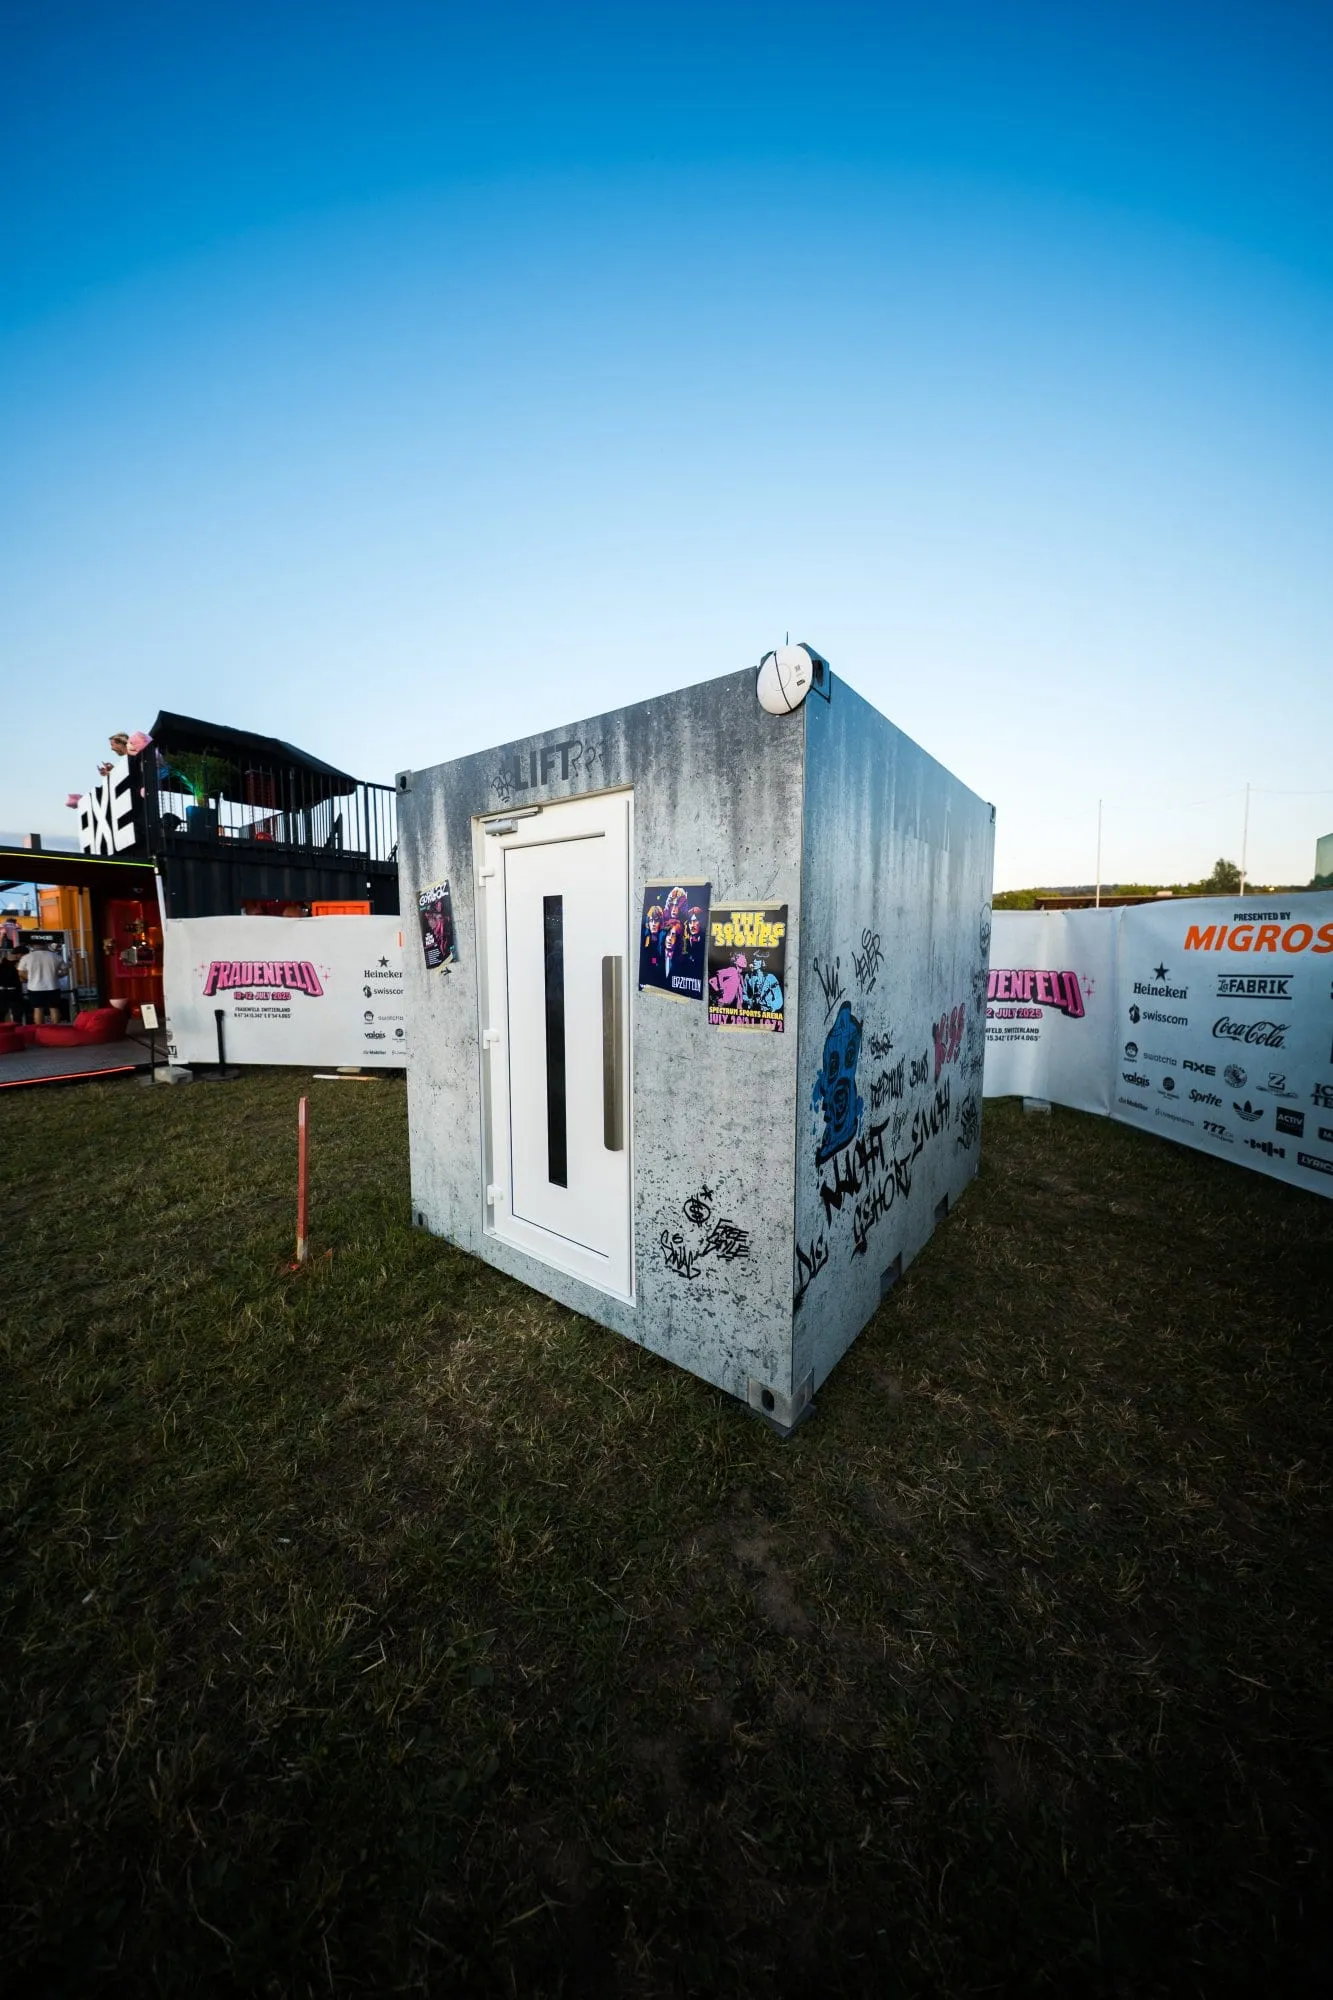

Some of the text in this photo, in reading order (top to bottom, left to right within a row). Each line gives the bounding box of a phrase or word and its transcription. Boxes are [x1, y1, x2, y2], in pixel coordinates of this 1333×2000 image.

[513, 740, 575, 792] LIFT
[78, 754, 136, 857] AXE
[730, 911, 765, 924] THE
[1233, 911, 1291, 922] PRESENTED BY
[711, 922, 786, 937] ROLLING
[1184, 923, 1333, 953] MIGROS
[714, 933, 780, 948] STONES
[203, 961, 324, 997] FRAUENFELD
[1229, 979, 1289, 994] FABRIK
[1133, 982, 1188, 999] Heineken
[994, 1007, 1017, 1019] JULY
[1017, 1007, 1043, 1019] 2025
[1142, 1009, 1188, 1026] swisscom
[1212, 1016, 1291, 1048] Coca-Cola
[1183, 1060, 1216, 1076] AXE
[1188, 1088, 1222, 1107] Sprite
[1277, 1114, 1303, 1125] ACTIV
[1301, 1155, 1333, 1172] LYRIC
